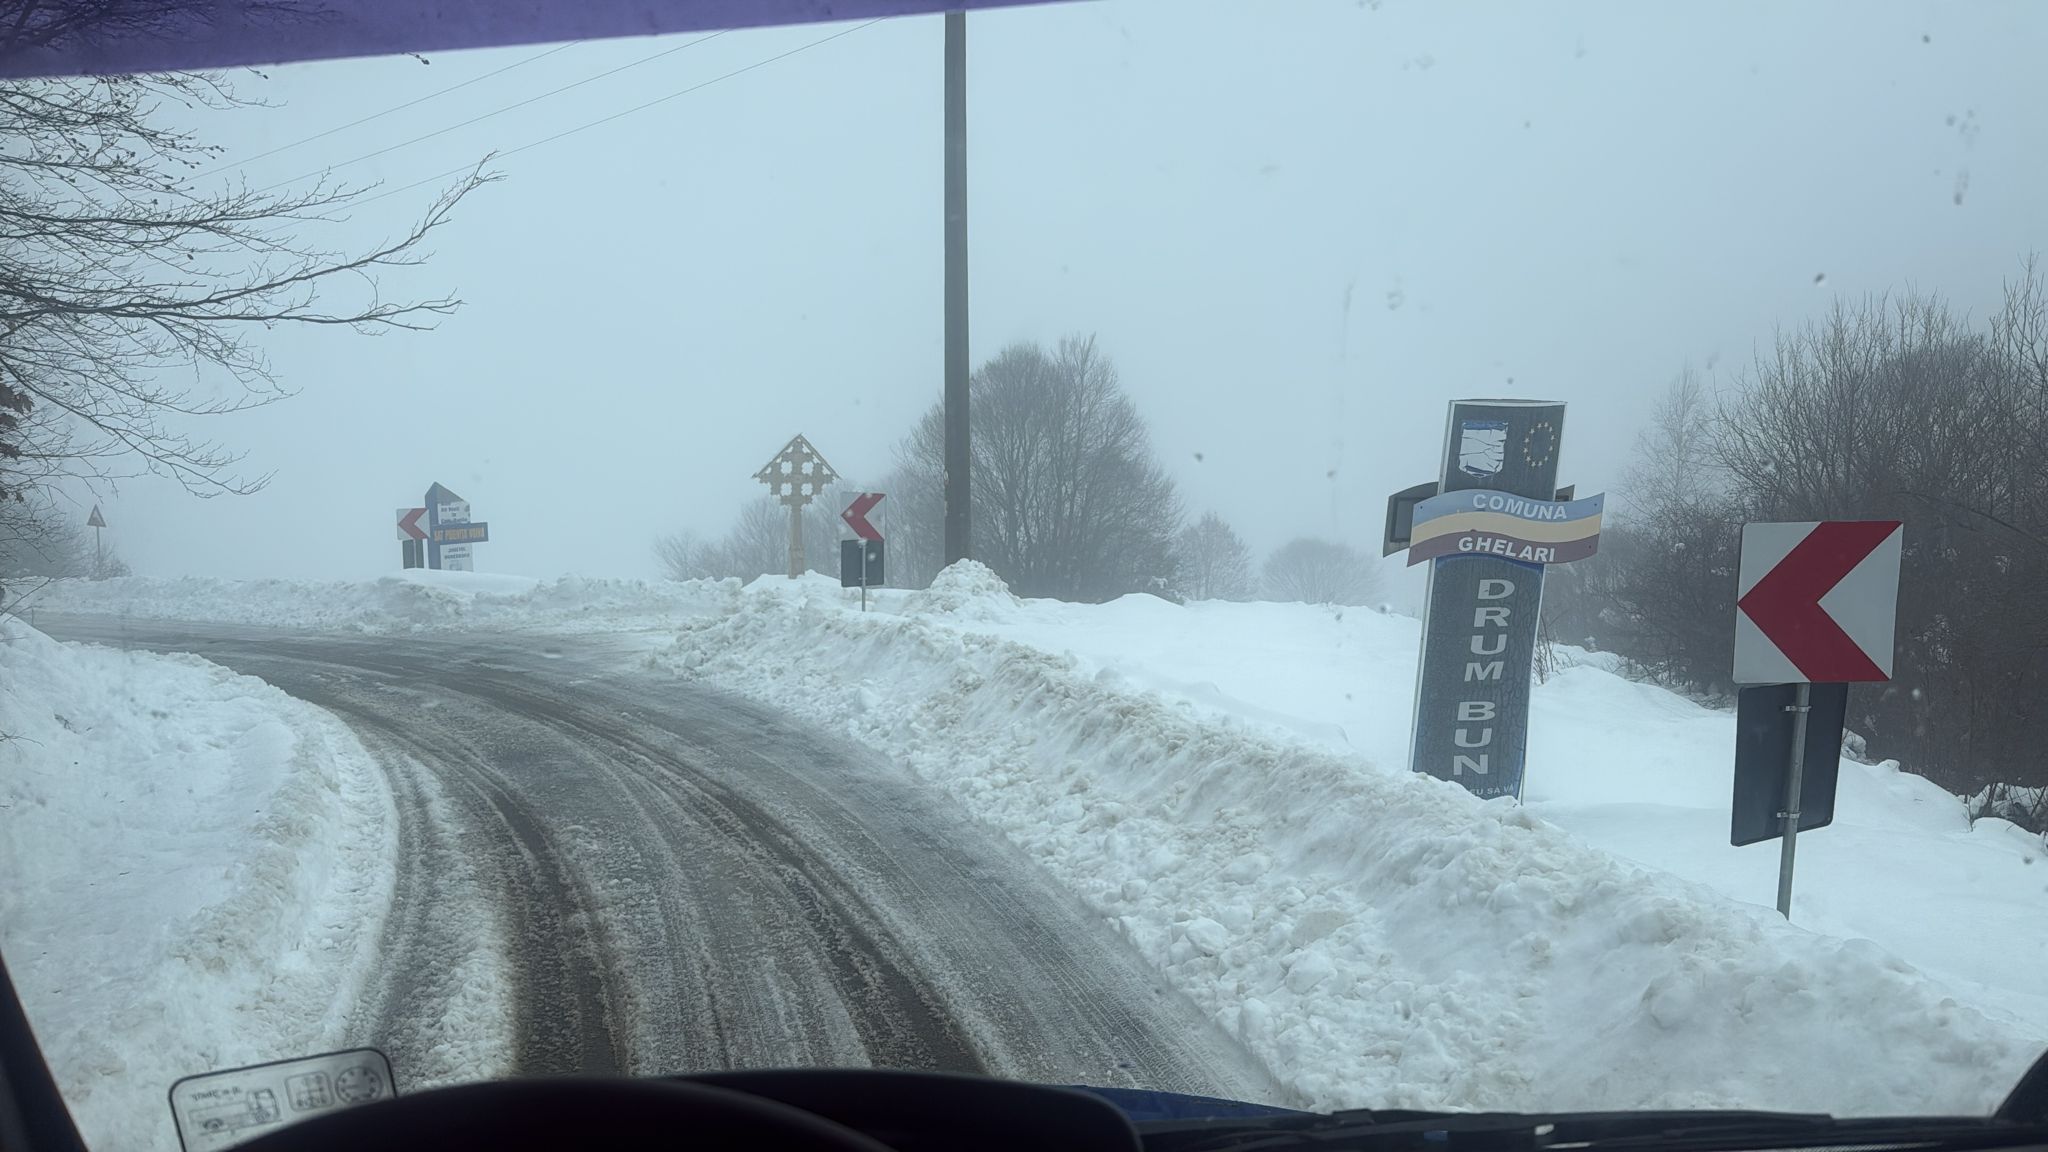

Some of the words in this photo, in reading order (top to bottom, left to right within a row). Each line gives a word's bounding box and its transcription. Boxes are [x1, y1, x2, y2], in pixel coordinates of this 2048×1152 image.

[1472, 493, 1568, 520] COMUNA
[1458, 537, 1555, 563] GHELARI
[1463, 578, 1516, 682] DRUM
[1453, 701, 1496, 776] BUN
